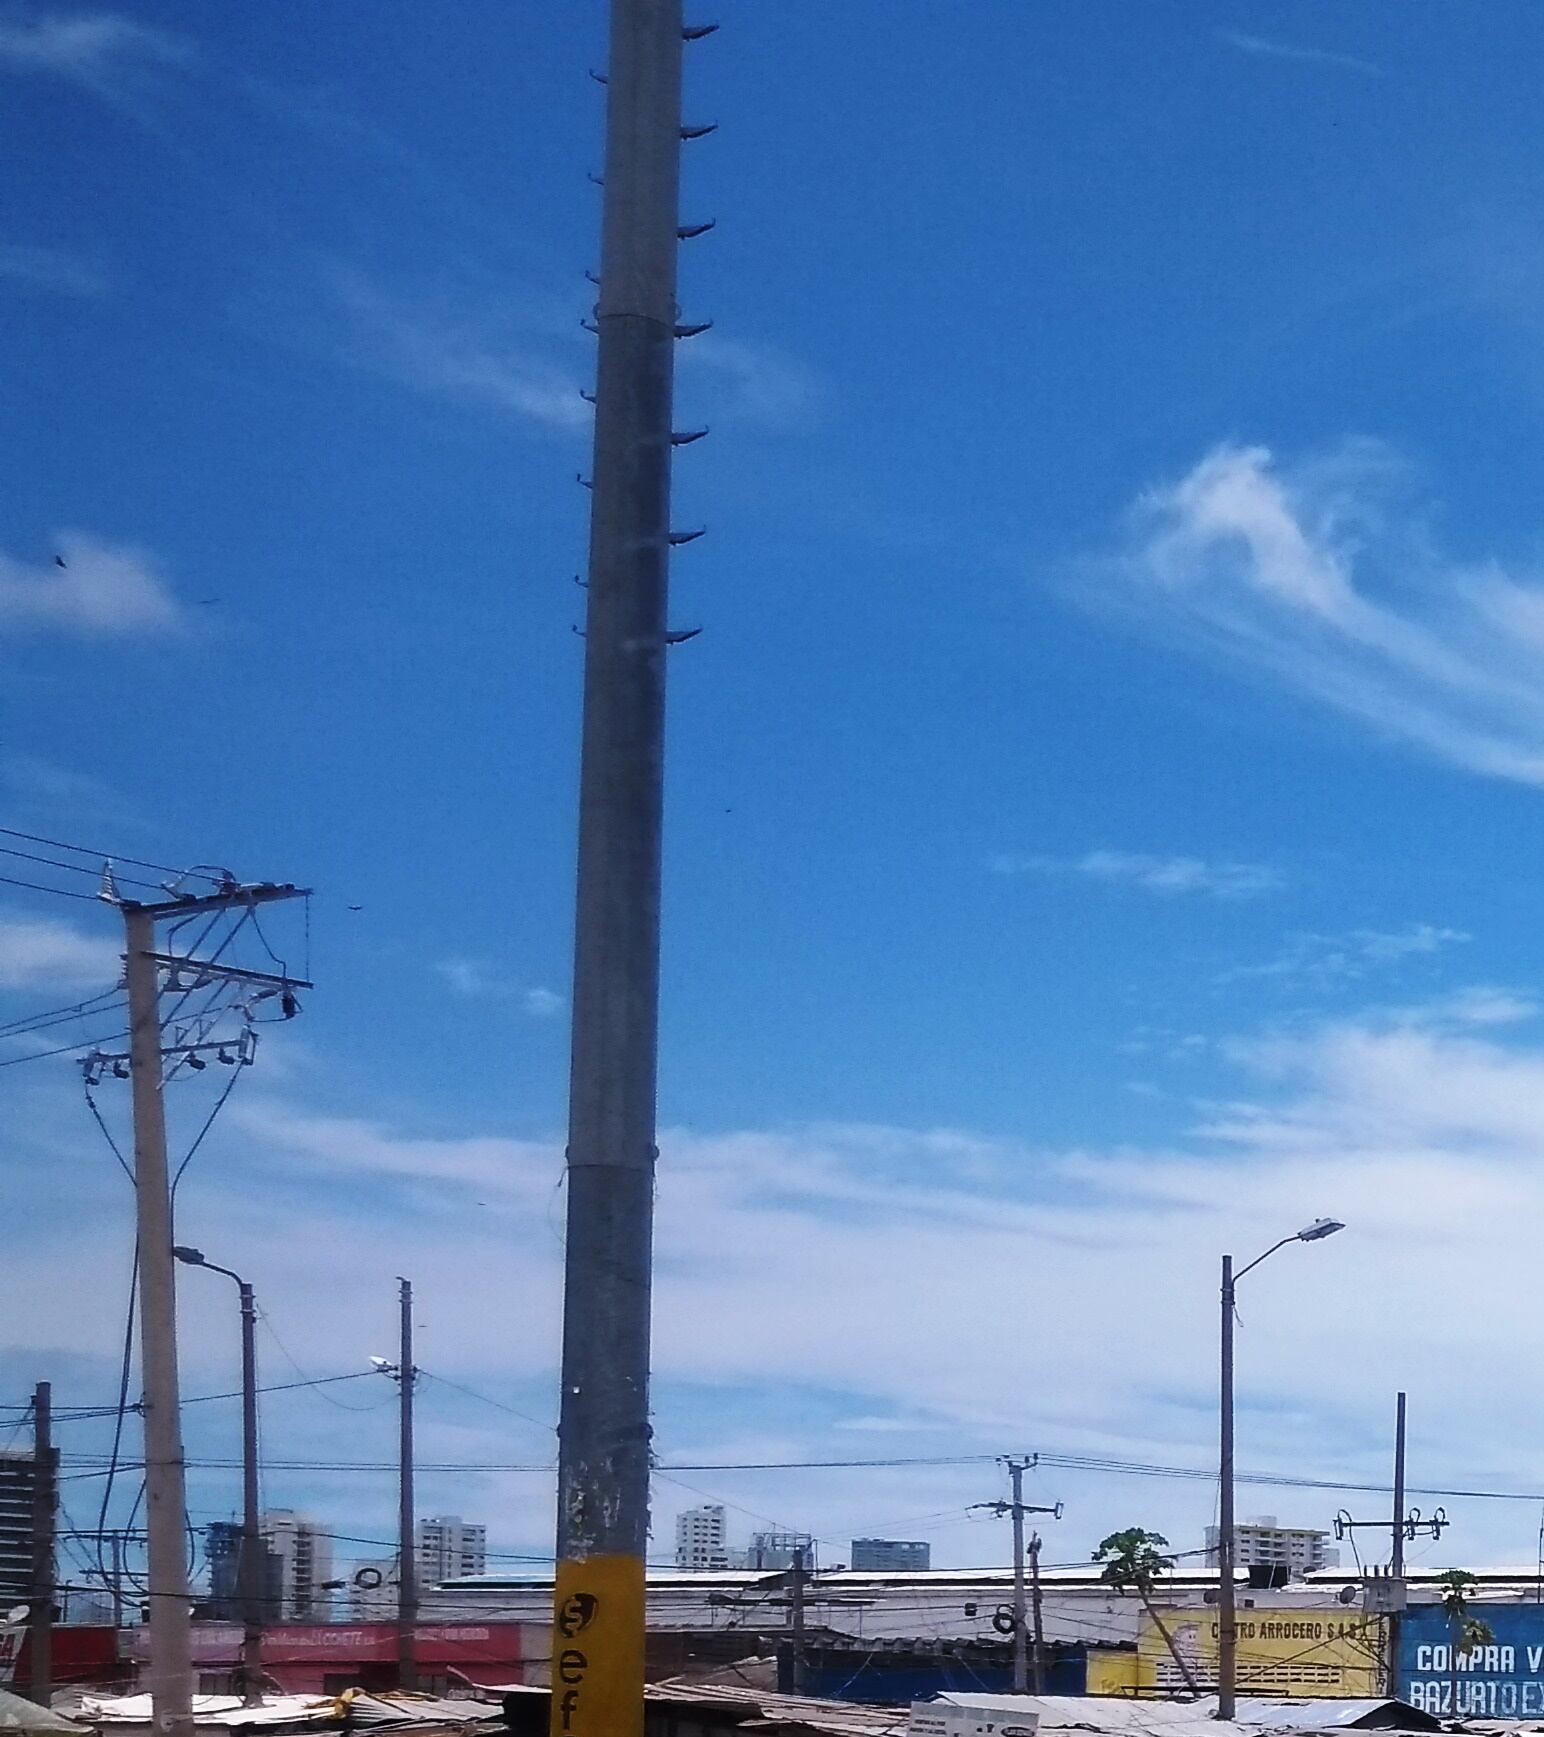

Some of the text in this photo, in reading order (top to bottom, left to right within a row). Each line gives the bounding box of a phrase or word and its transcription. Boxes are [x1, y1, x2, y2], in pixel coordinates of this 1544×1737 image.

[1211, 1622, 1255, 1639] CTRO
[1259, 1622, 1322, 1639] ARROCERO
[1417, 1646, 1514, 1672] COMPRA
[1410, 1681, 1518, 1714] BAZURTO
